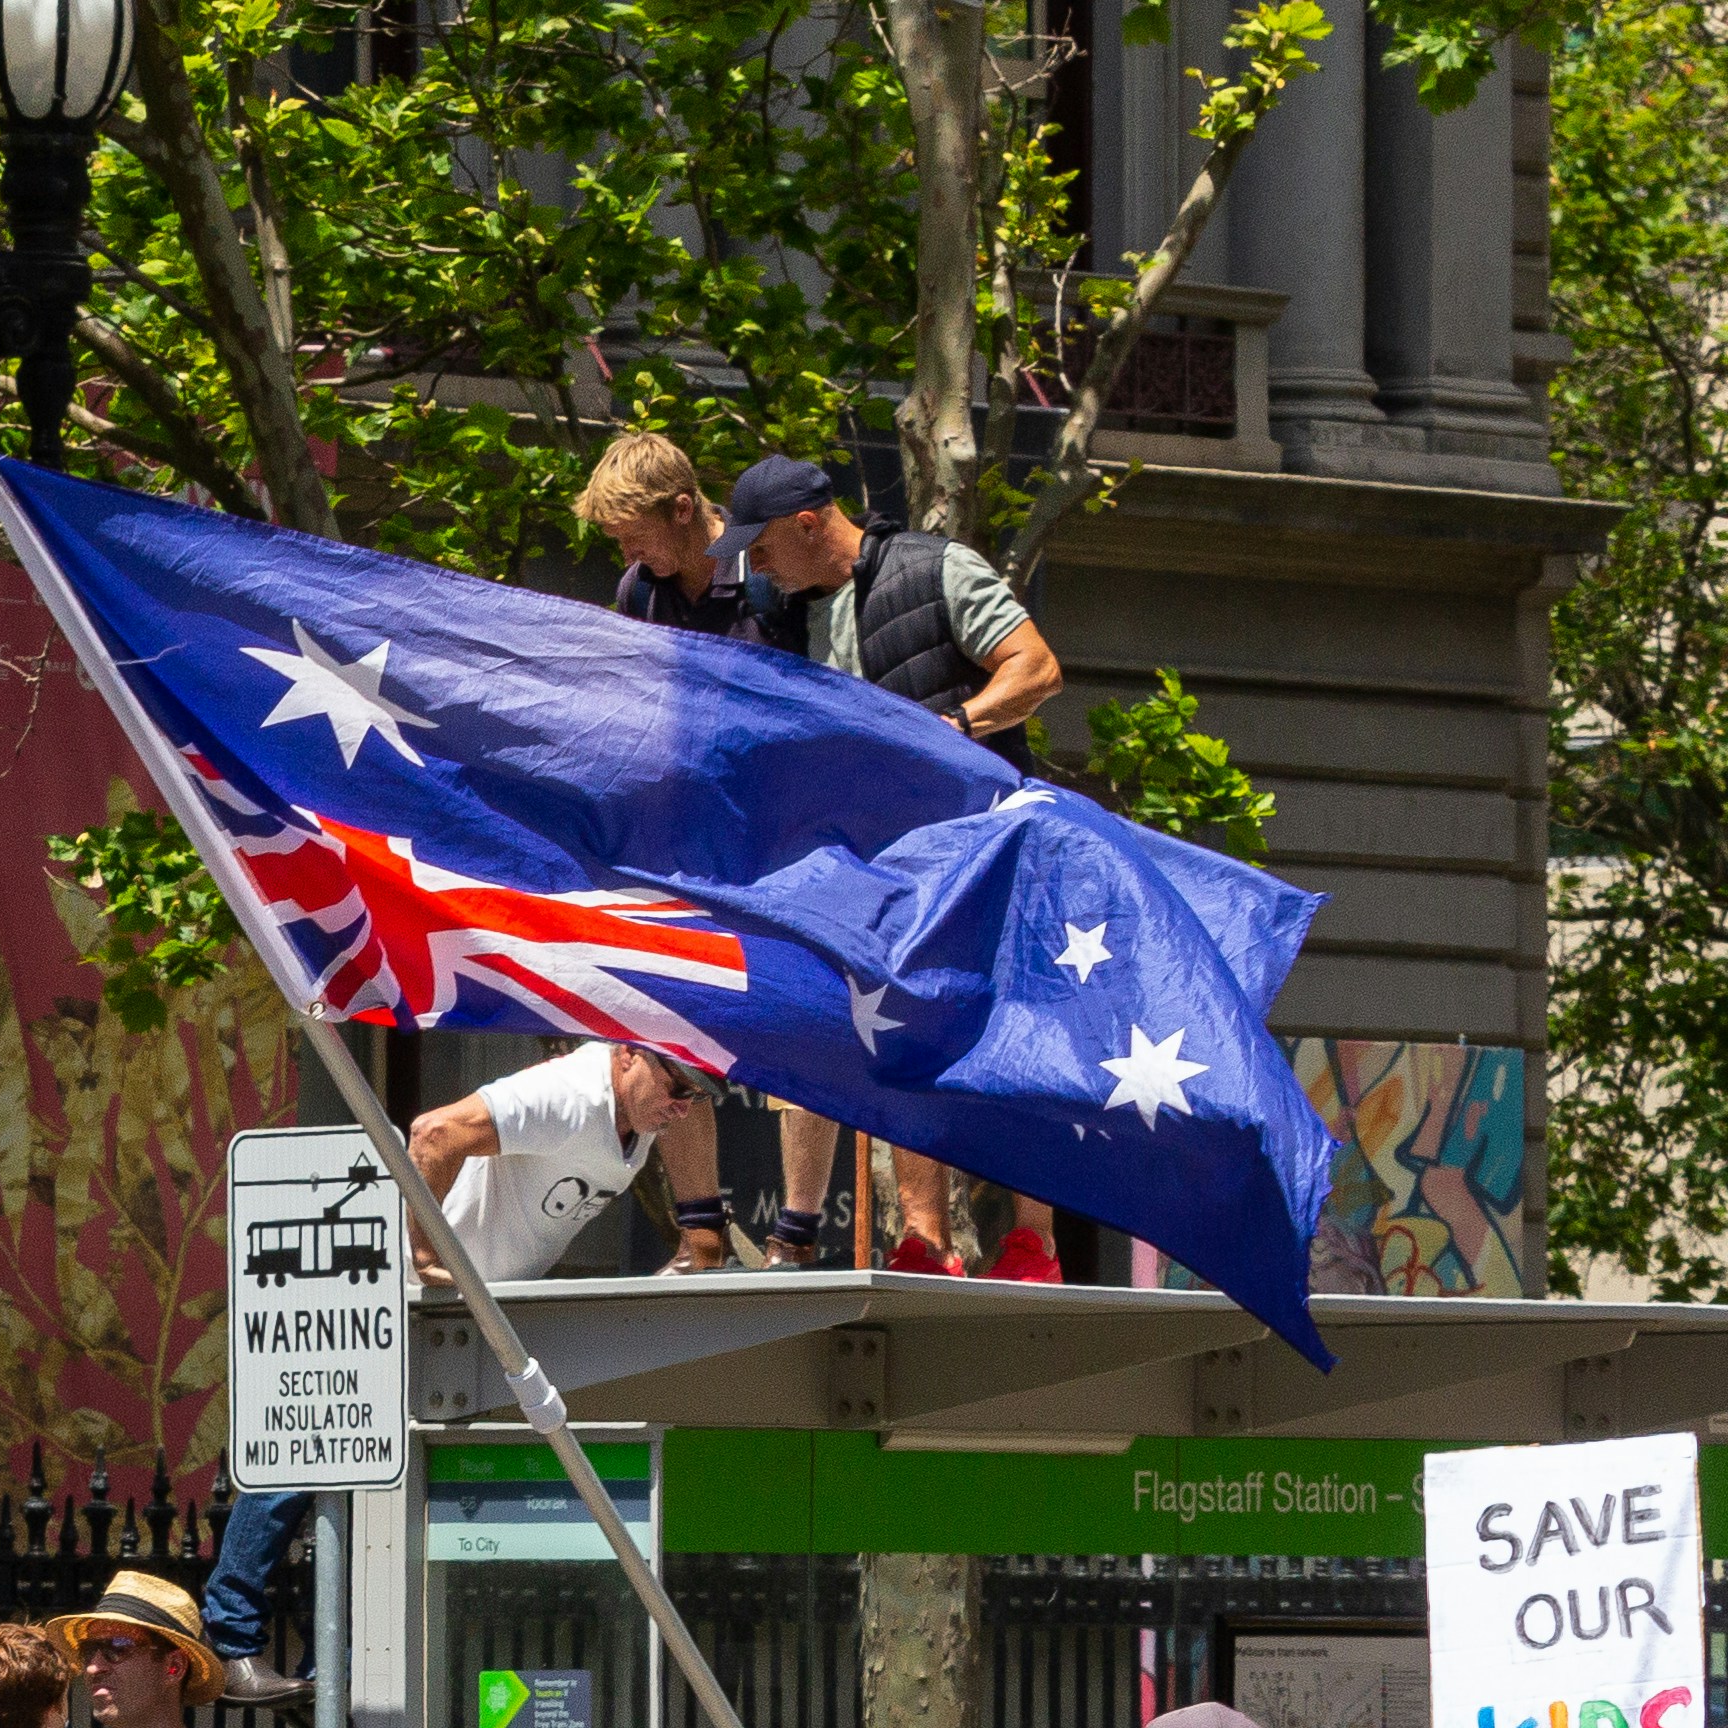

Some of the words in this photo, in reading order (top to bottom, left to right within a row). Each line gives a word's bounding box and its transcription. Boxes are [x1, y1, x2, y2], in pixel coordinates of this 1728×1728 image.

[244, 1306, 393, 1354] WARNING
[278, 1369, 358, 1397] SECTION
[264, 1403, 372, 1432] INSULATOR
[245, 1439, 279, 1467] MID
[290, 1436, 393, 1465] PLATFORM
[1133, 1470, 1265, 1523] Flagstaff
[1272, 1471, 1377, 1514] Station
[458, 1537, 472, 1552] To
[475, 1536, 500, 1555] City
[1475, 1483, 1667, 1575] SAVE
[1515, 1576, 1675, 1650] OUR
